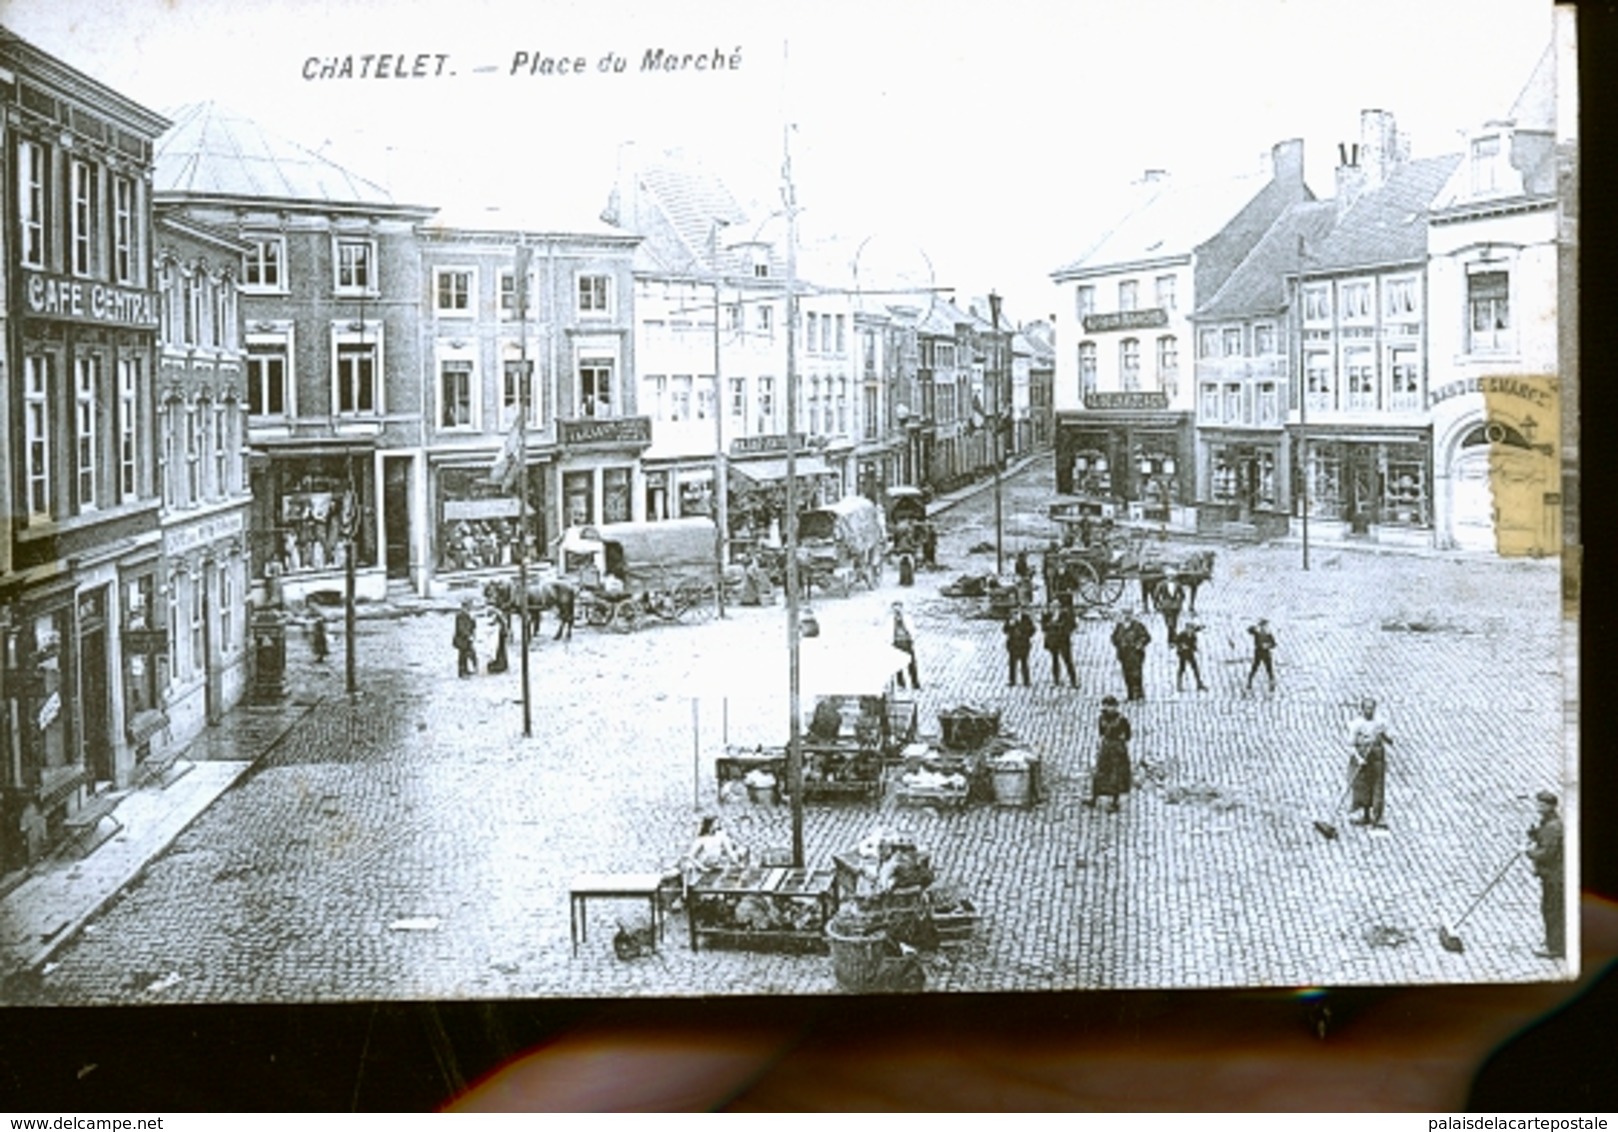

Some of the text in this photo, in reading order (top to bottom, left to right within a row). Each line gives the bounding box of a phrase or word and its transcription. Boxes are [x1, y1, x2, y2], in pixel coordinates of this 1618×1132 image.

[509, 50, 588, 77] Place
[597, 52, 627, 74] du
[640, 46, 743, 73] Marché
[28, 273, 160, 325] CAFE CENTRAL
